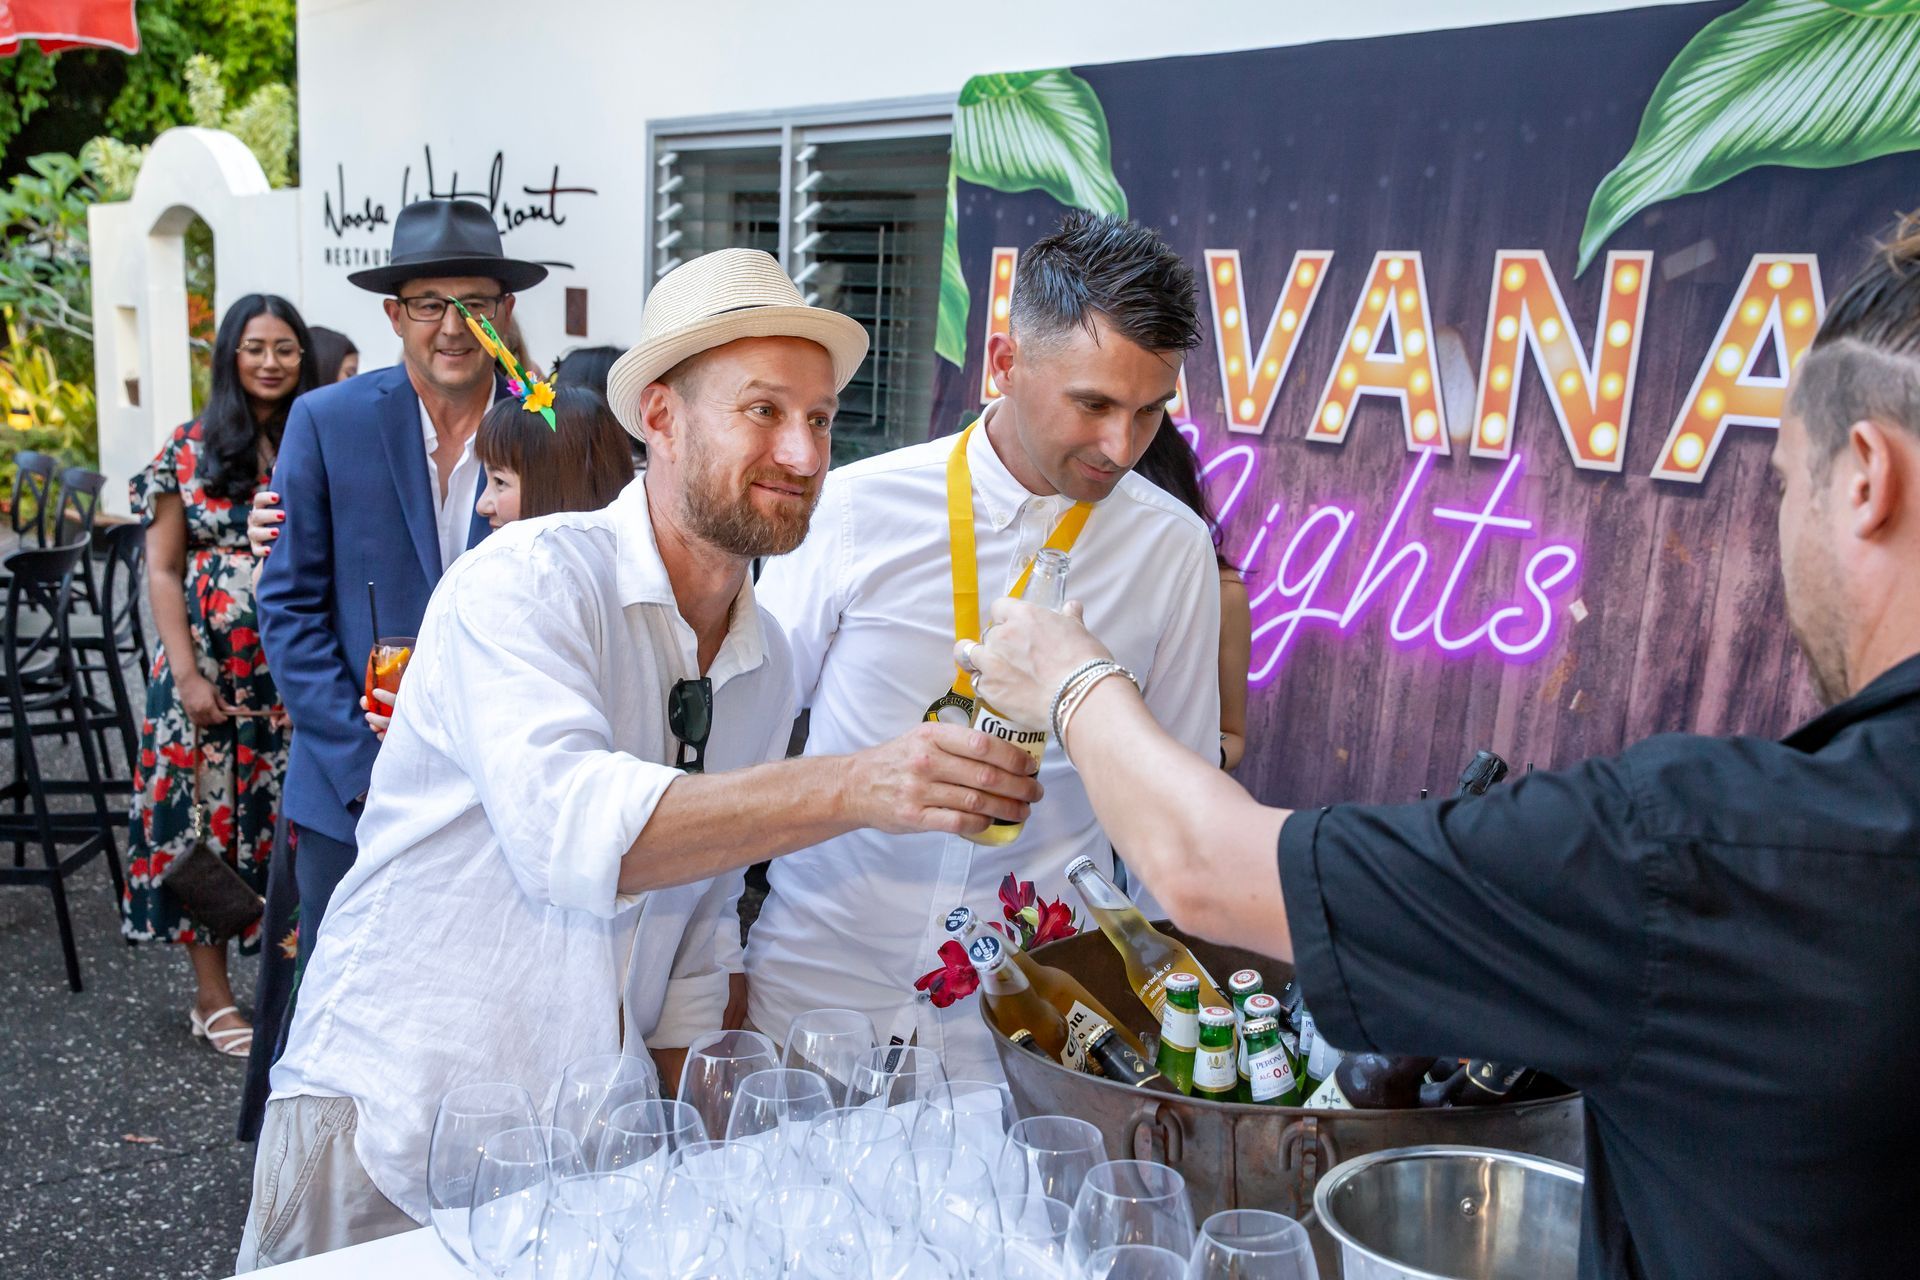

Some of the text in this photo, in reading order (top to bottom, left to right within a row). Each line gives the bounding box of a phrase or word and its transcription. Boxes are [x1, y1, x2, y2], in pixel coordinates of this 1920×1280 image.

[325, 163, 390, 237] Noosa
[981, 716, 1046, 744] Corona
[1273, 1063, 1289, 1079] 0.0
